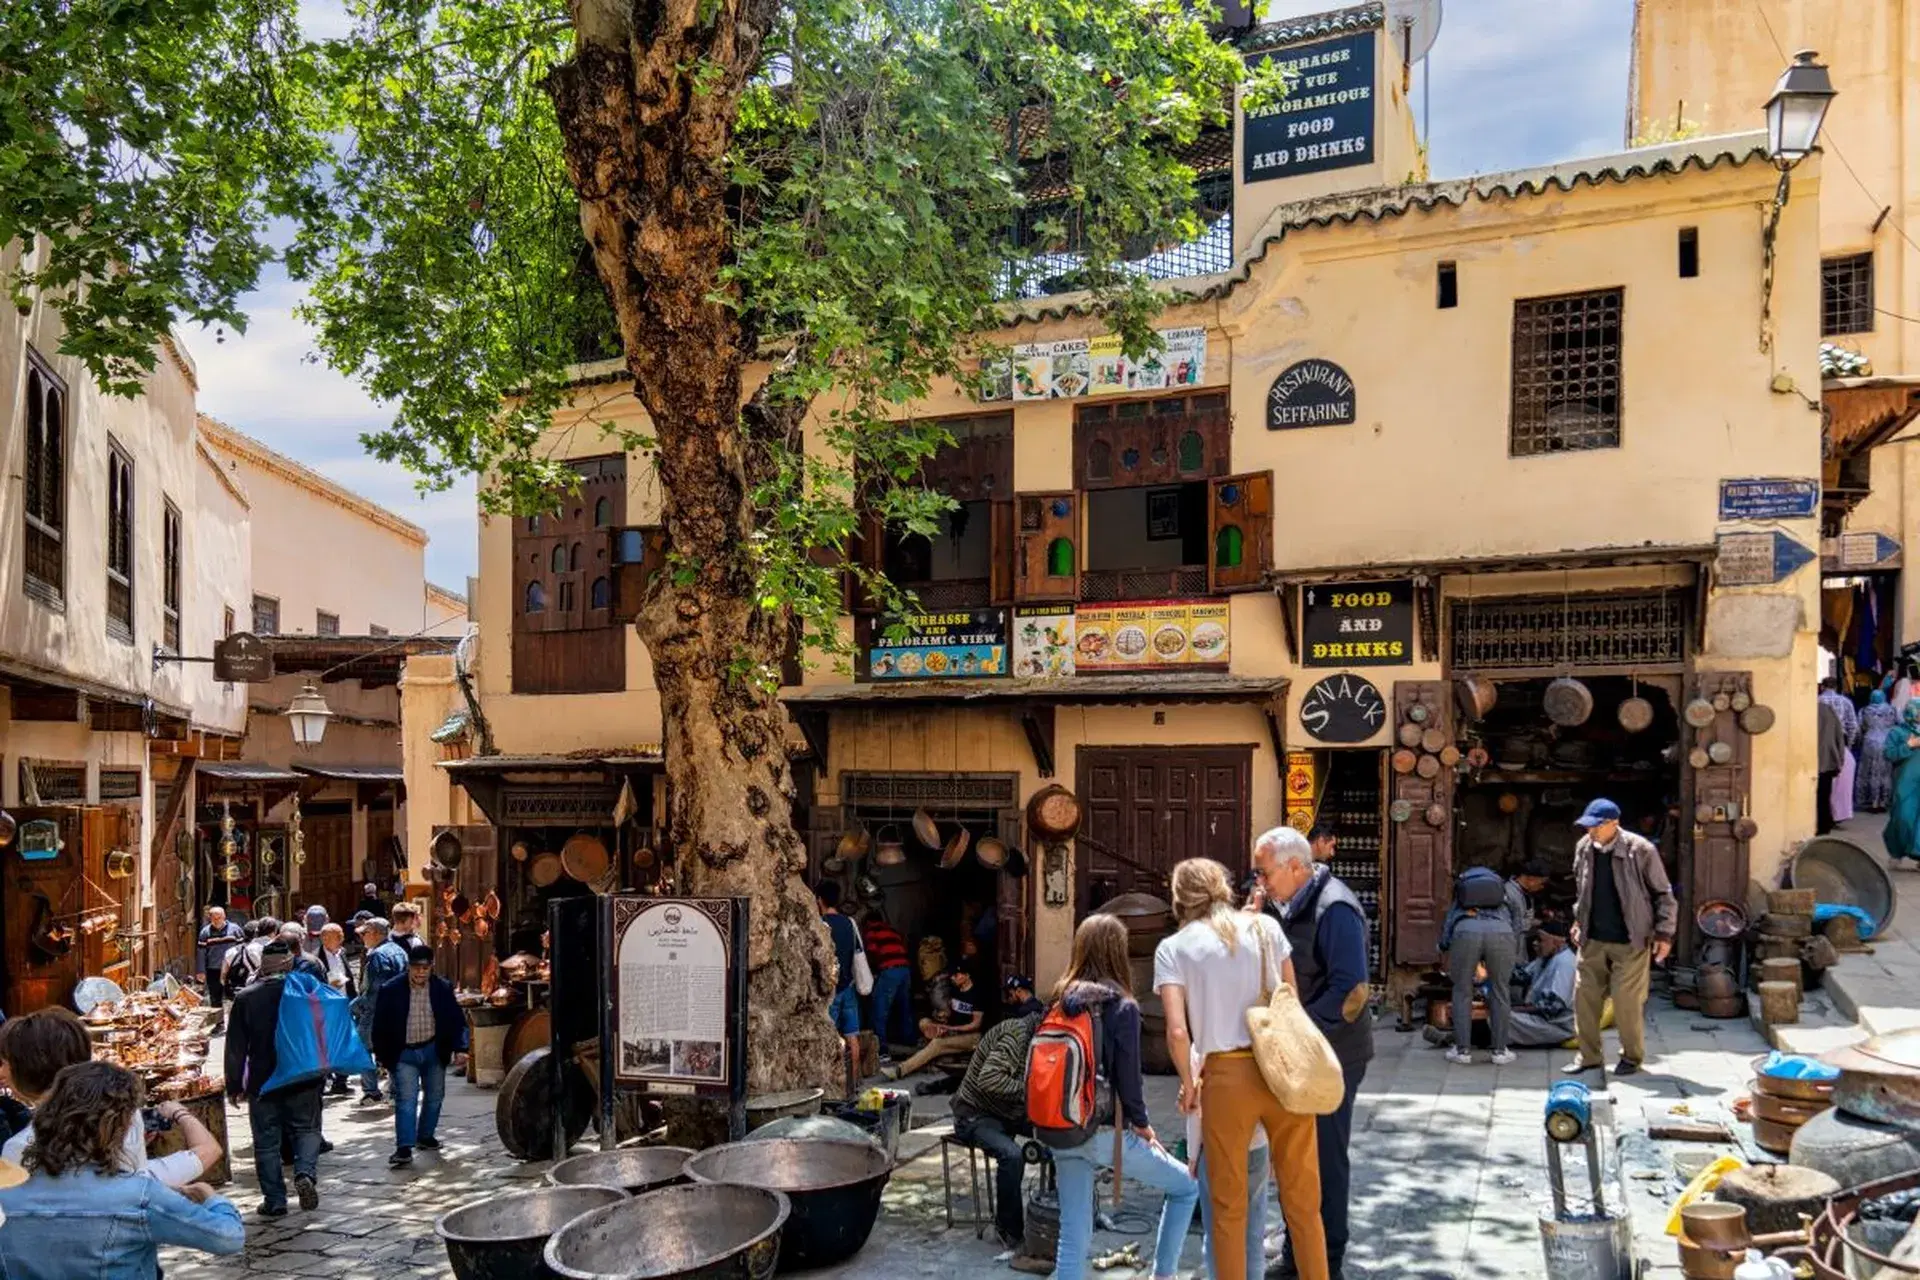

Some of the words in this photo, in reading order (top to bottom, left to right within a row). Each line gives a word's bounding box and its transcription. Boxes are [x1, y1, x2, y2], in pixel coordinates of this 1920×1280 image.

[1271, 49, 1351, 75] ERRASSE
[1284, 79, 1300, 92] T
[1305, 71, 1338, 88] VUE
[1287, 117, 1335, 138] FOOD
[1252, 150, 1289, 171] AND
[1295, 136, 1366, 163] DRINKS
[1053, 342, 1089, 353] CAKES
[1270, 364, 1353, 404] RESTAURANT
[1273, 402, 1350, 424] SEFFARINE
[1331, 592, 1392, 608] FOOD
[911, 613, 971, 626] ERRASSE
[1340, 618, 1383, 632] AND
[878, 635, 956, 647] PAORAMIC
[960, 633, 997, 644] VIEW
[926, 627, 947, 635] AND
[1313, 641, 1404, 659] DRINKS
[1301, 677, 1384, 733] SNACK
